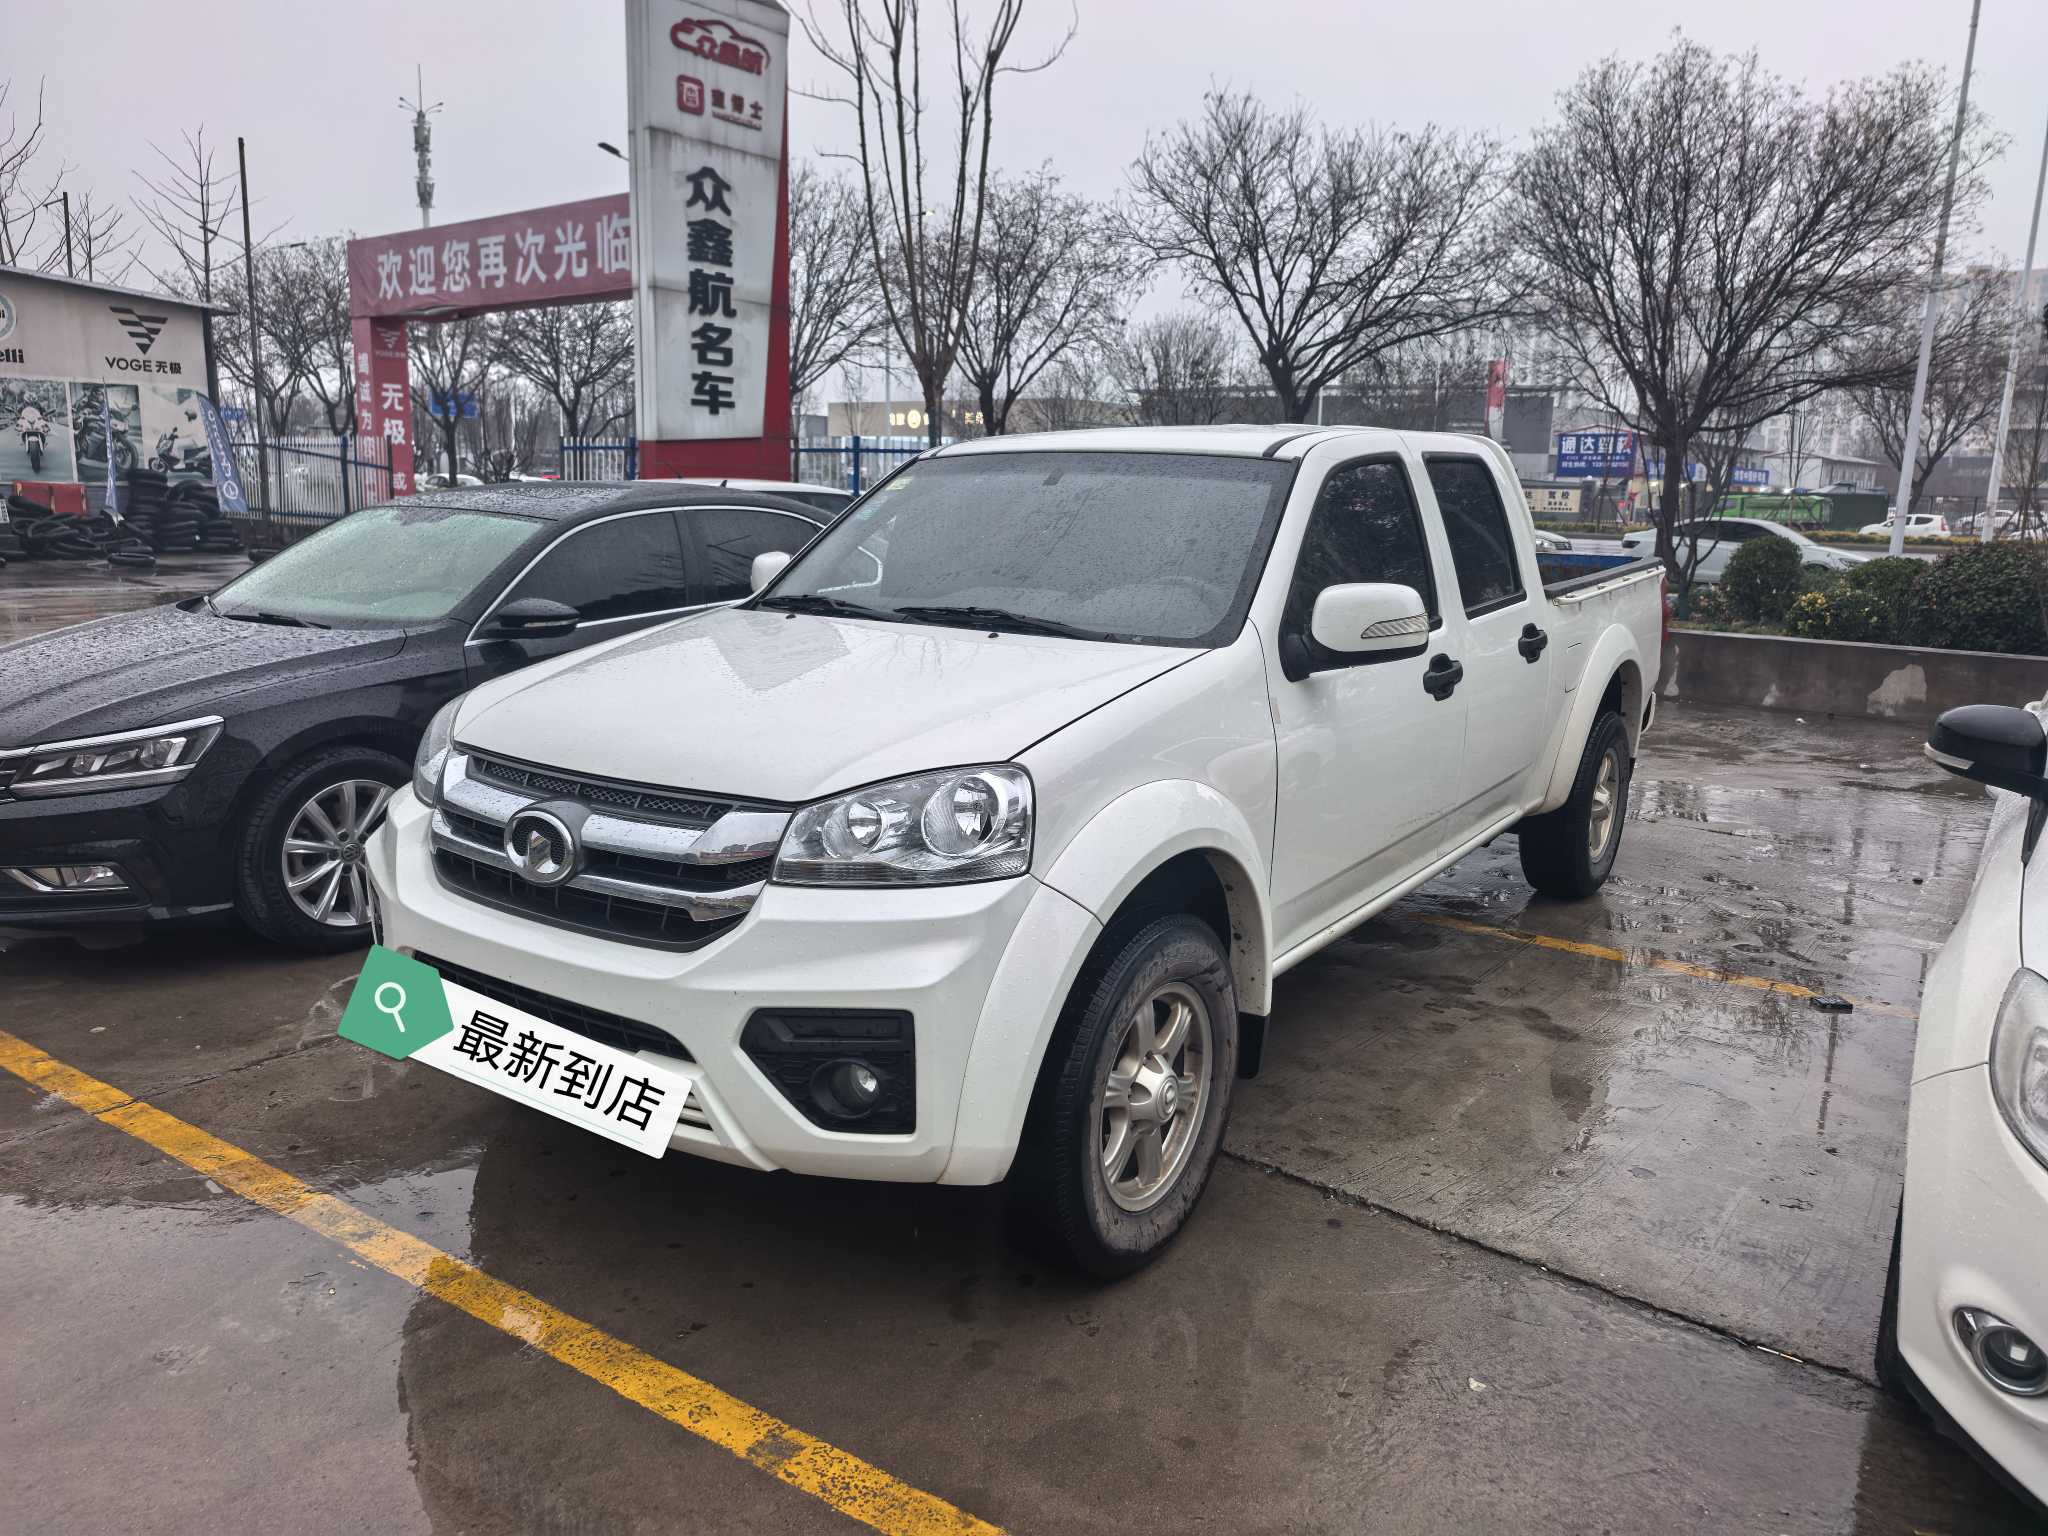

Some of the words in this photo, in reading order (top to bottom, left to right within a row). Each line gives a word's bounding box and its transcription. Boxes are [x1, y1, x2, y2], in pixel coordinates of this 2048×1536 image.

[376, 212, 631, 300] 欢迎您再次光临
[686, 166, 737, 415] 众鑫航名车
[105, 356, 152, 373] VOGE
[156, 360, 181, 374] 无极
